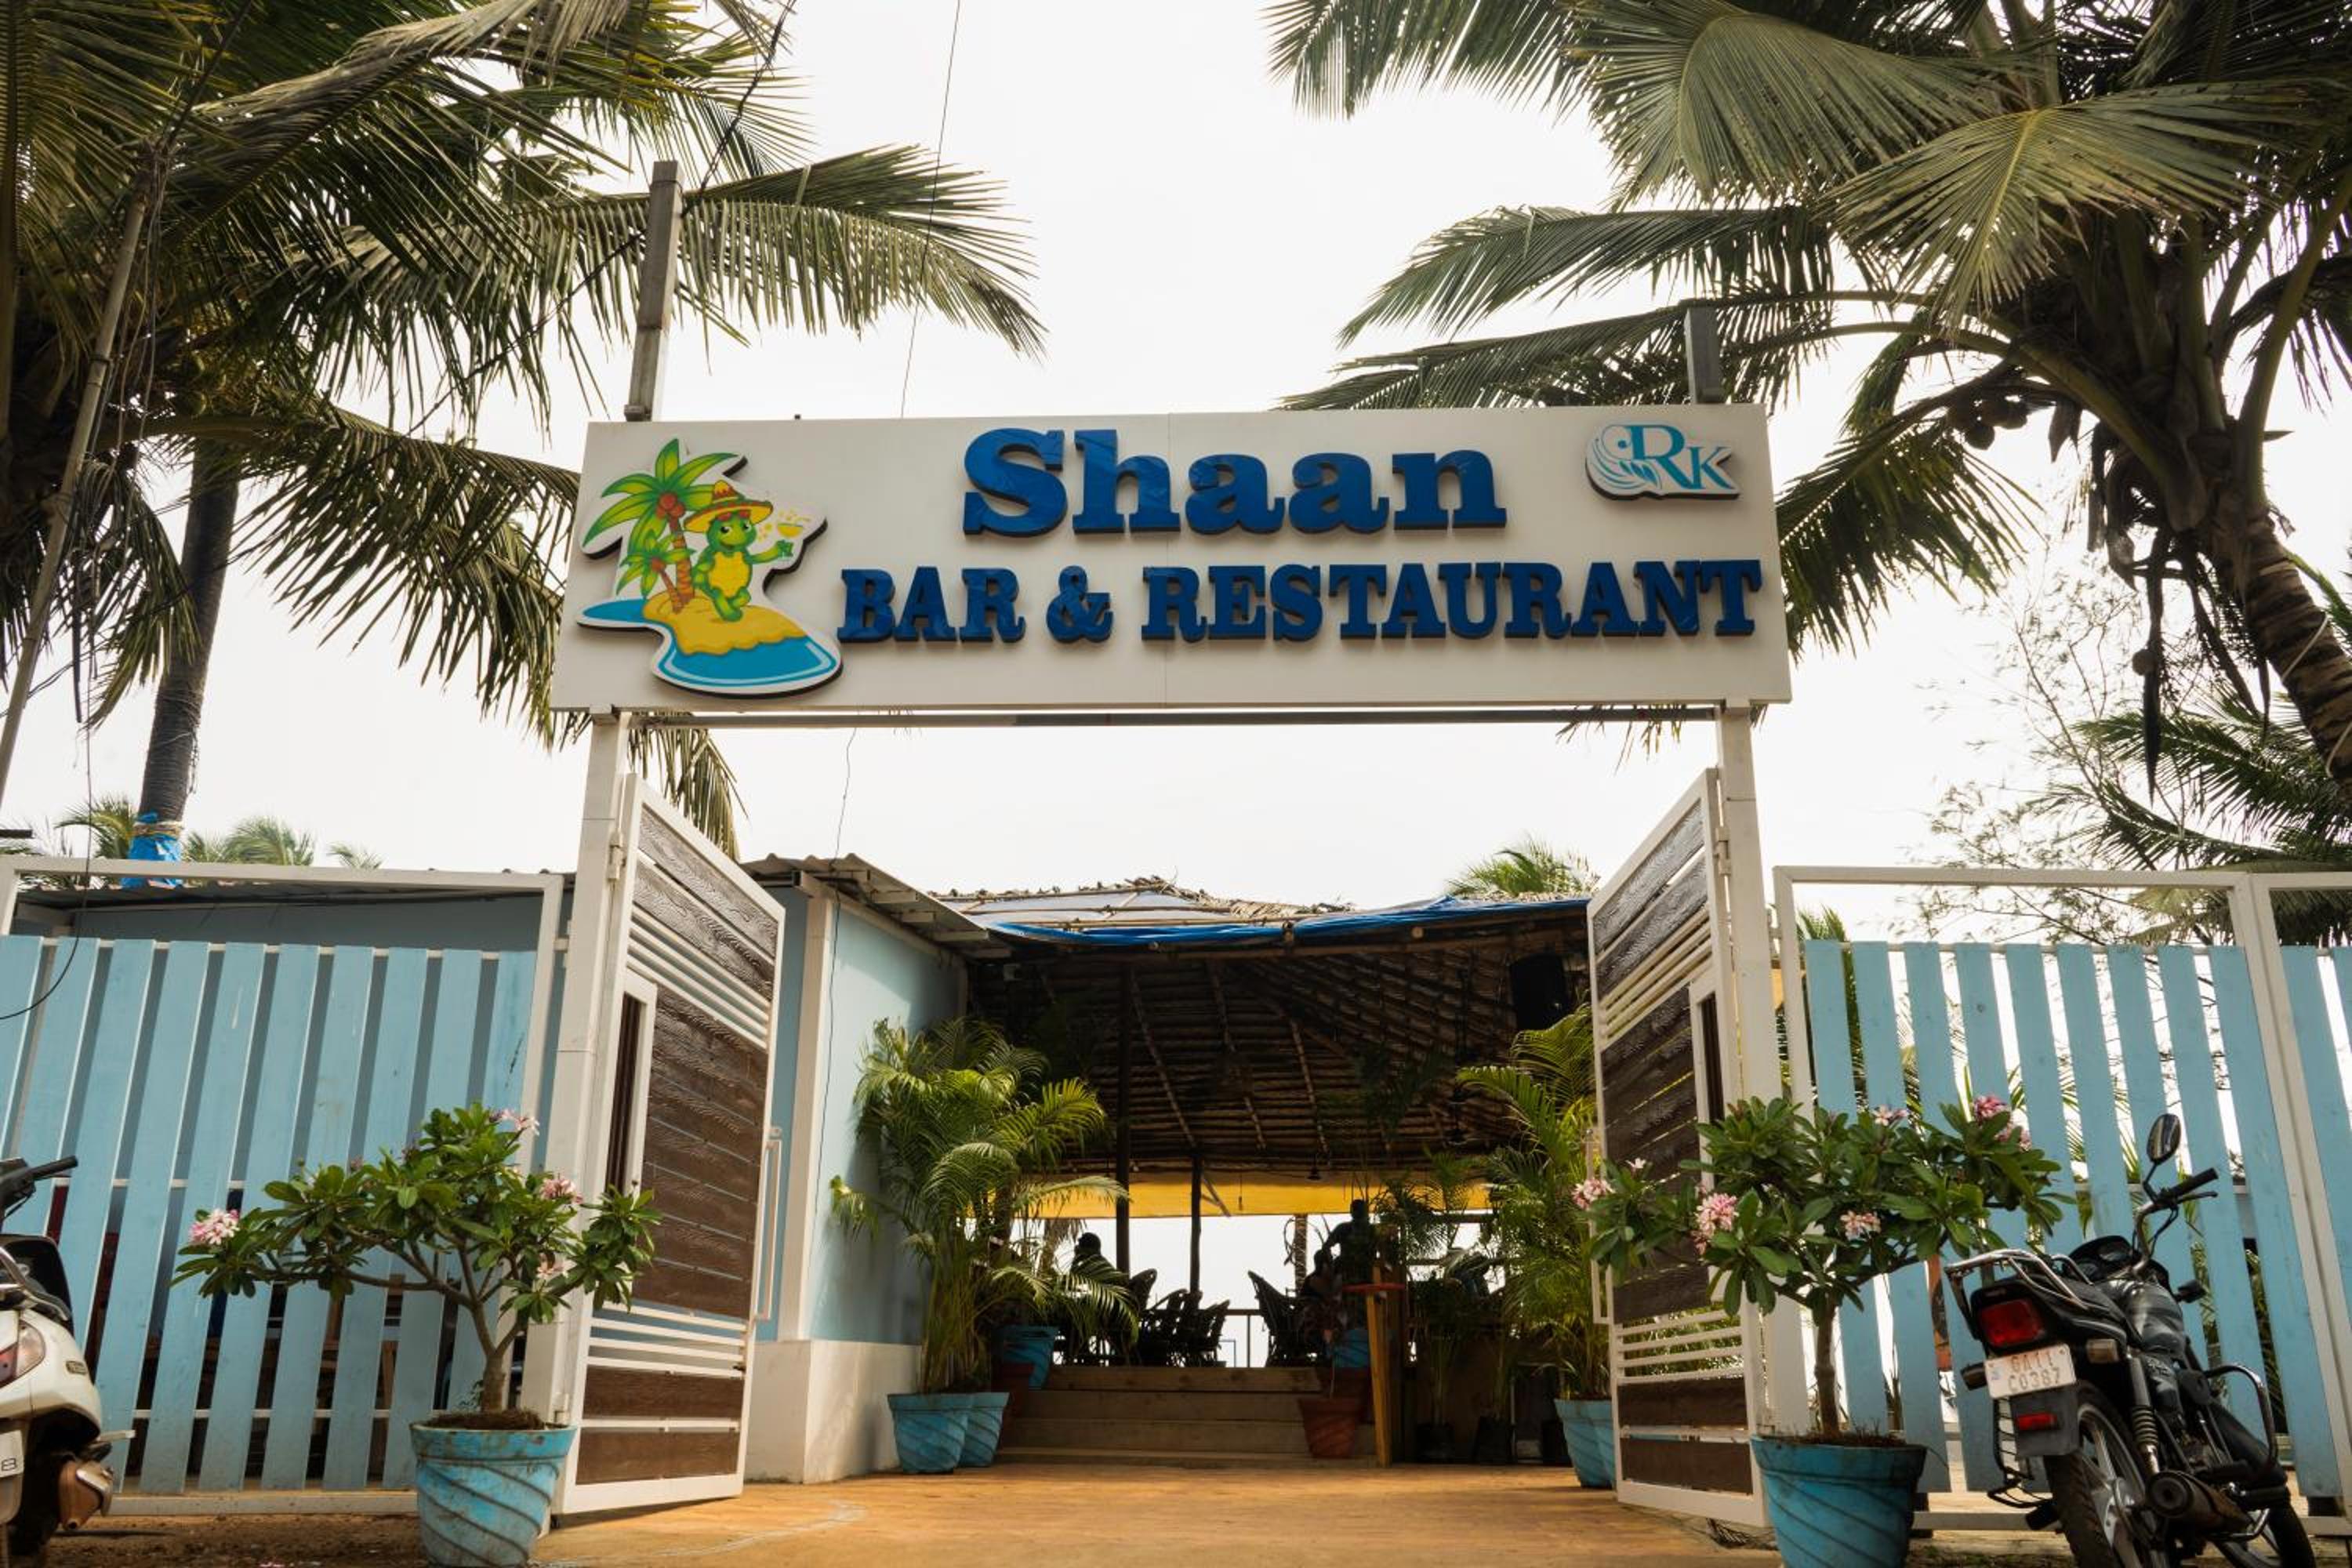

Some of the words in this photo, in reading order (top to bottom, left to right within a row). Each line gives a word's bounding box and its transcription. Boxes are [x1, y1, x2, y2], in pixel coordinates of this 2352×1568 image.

[963, 427, 1507, 537] Shaan
[1624, 424, 1737, 490] RK
[837, 565, 1026, 643] BAR
[1046, 565, 1113, 644] &
[1142, 560, 1762, 643] RESTAURANT
